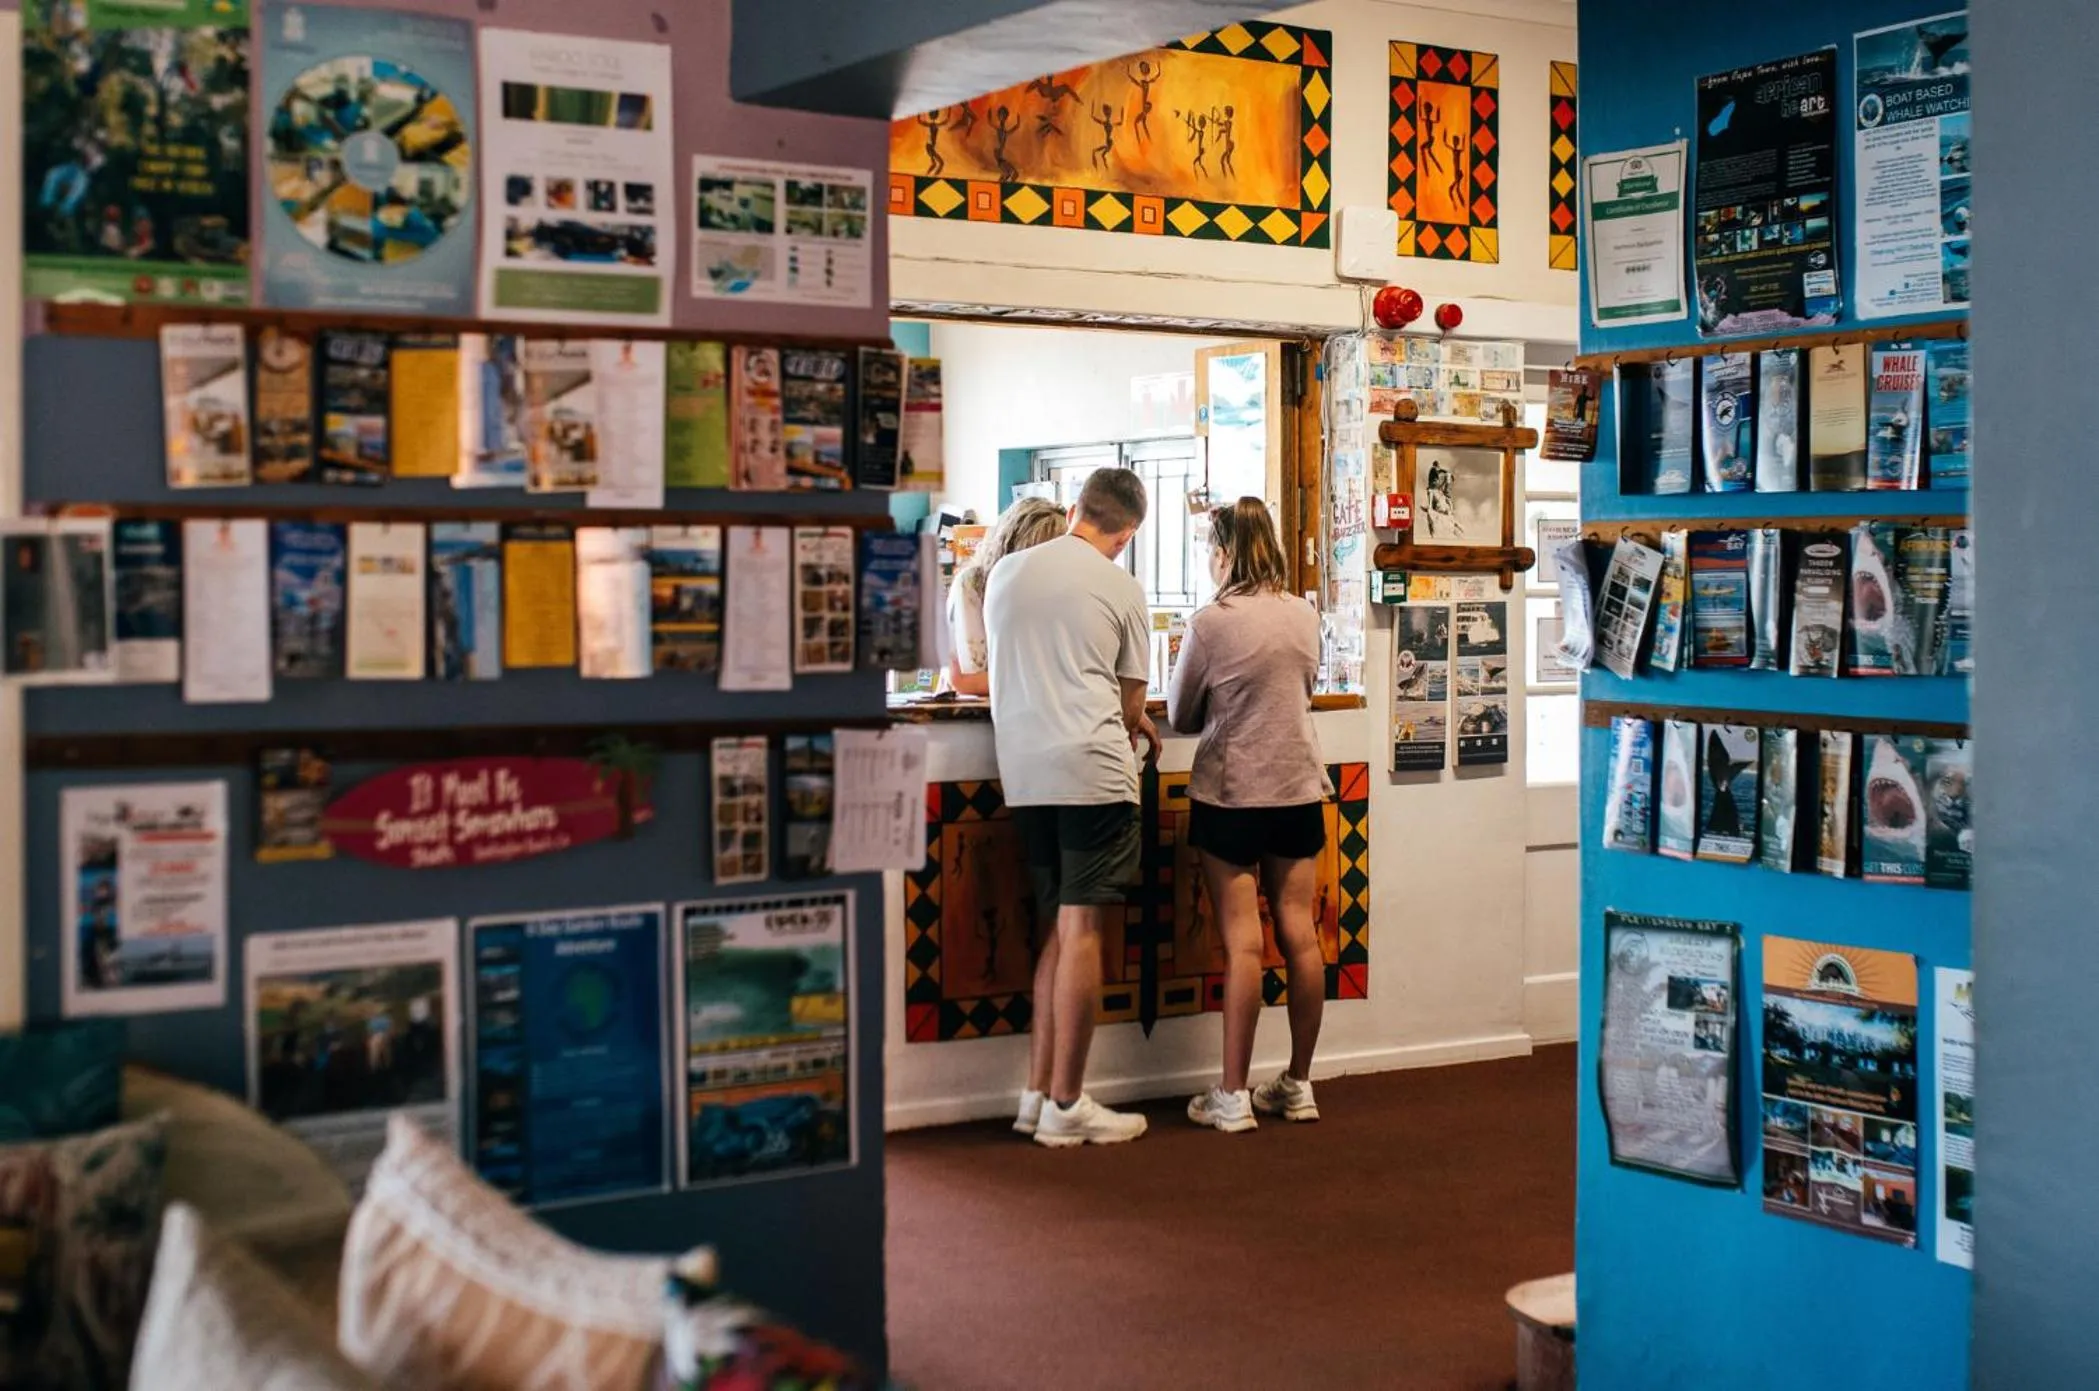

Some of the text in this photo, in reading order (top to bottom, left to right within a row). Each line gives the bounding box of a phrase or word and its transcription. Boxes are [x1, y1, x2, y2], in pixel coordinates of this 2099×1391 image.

[1782, 57, 1799, 69] with
[1886, 82, 1953, 107] BOAT BASED
[1887, 105, 1923, 122] WHALE
[1883, 354, 1919, 373] WHALE
[1876, 374, 1923, 392] CRUISES
[1332, 499, 1362, 525] CAFE
[1881, 862, 1902, 874] THIS
